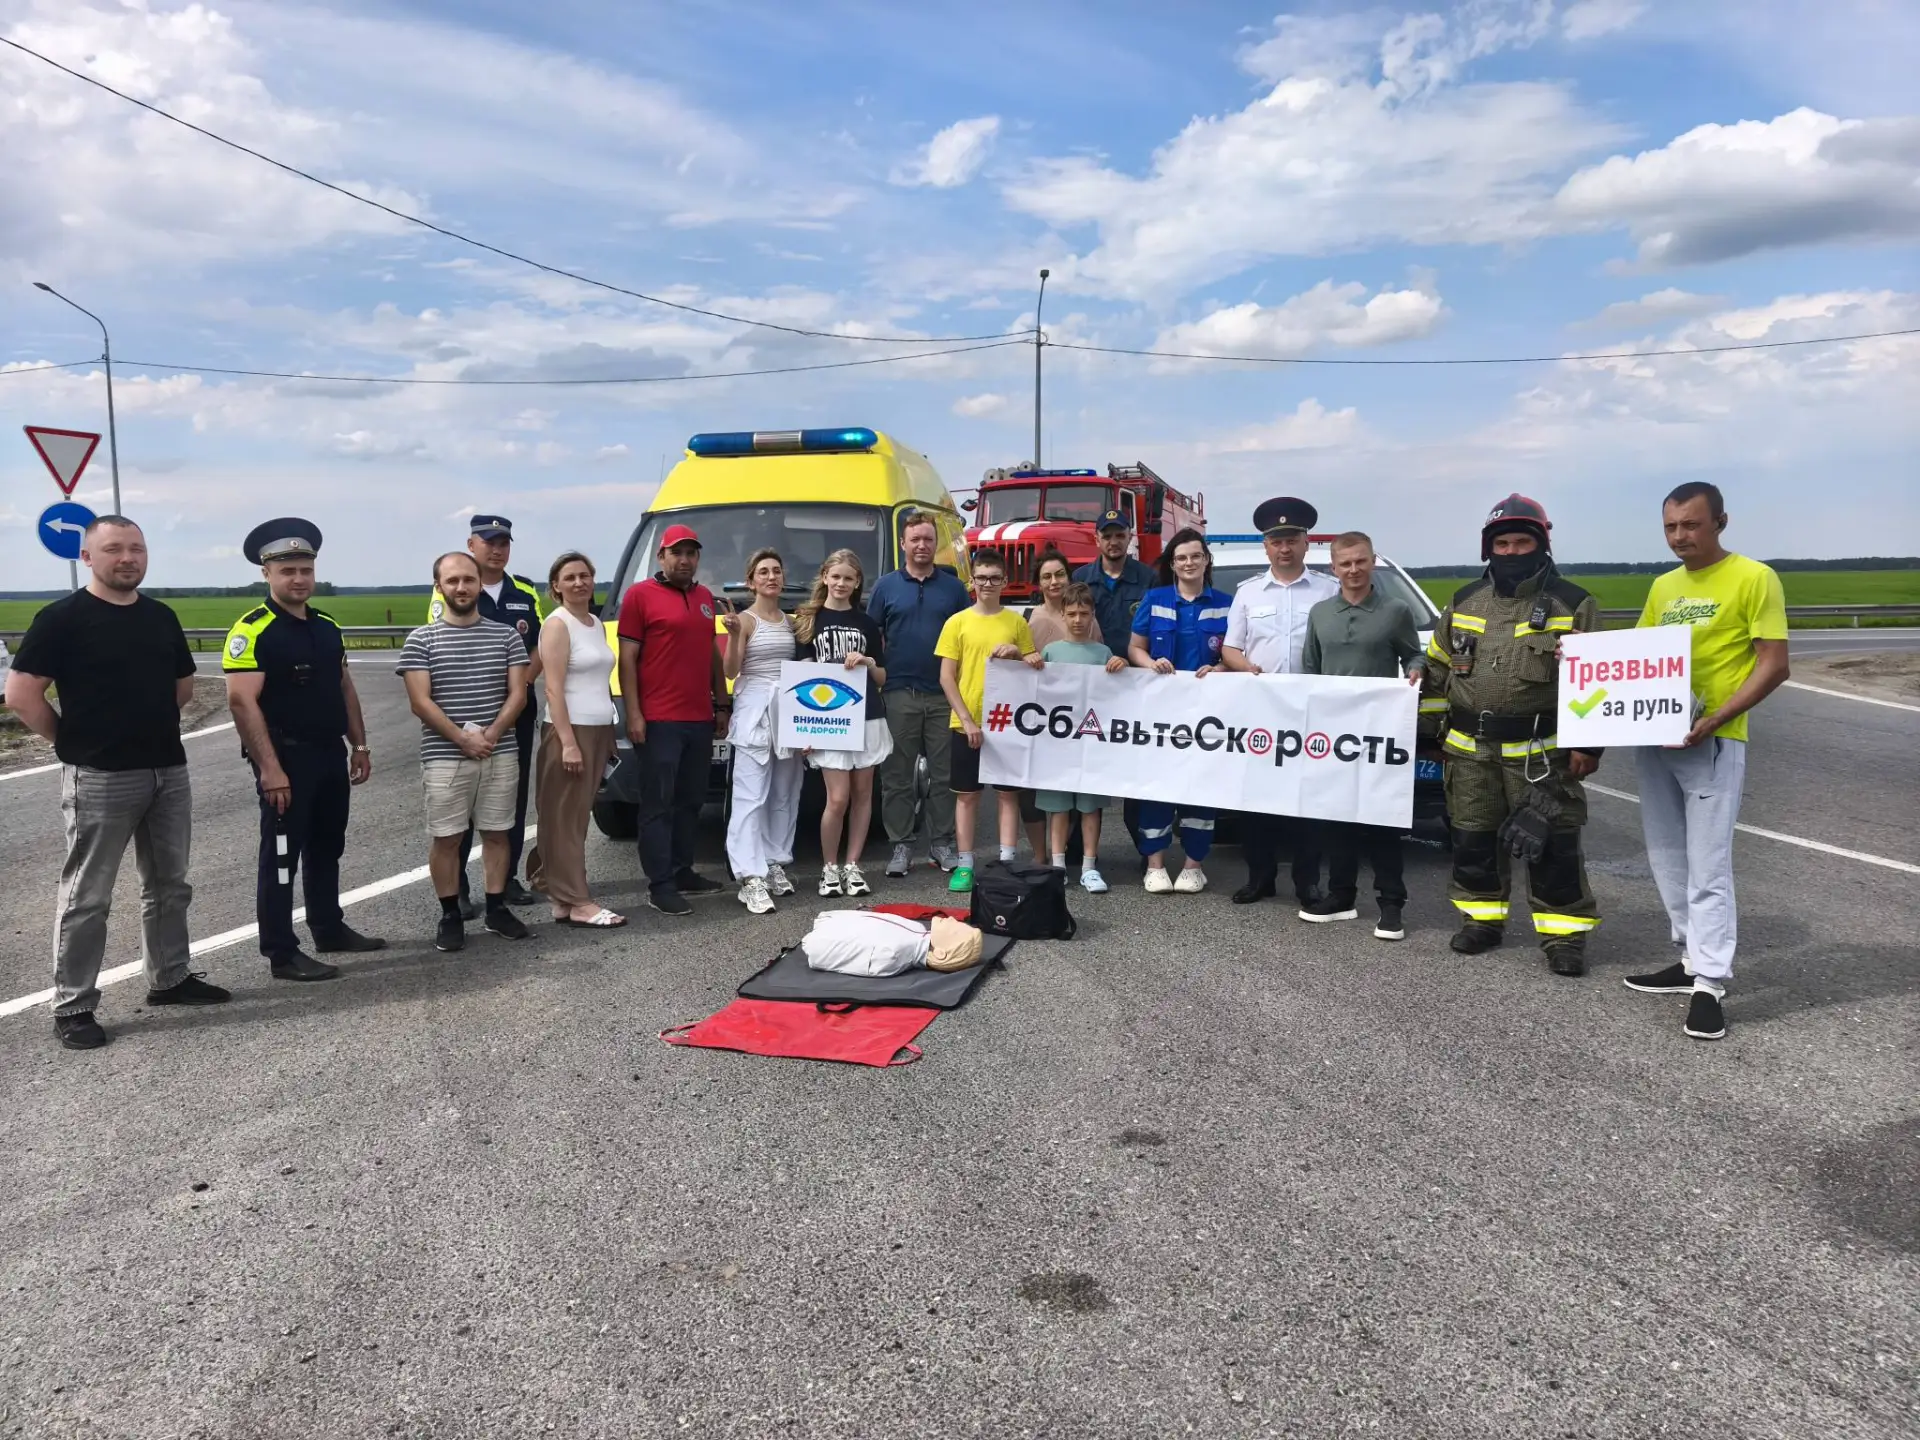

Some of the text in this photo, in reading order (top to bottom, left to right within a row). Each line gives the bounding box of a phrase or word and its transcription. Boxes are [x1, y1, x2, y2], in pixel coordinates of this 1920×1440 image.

[1566, 656, 1684, 690] Трезвым
[1602, 698, 1683, 721] за руль
[793, 715, 851, 726] ВНИМАНИЕ
[796, 725, 848, 735] НА ДОРОГУ!
[1419, 760, 1437, 773] 72
